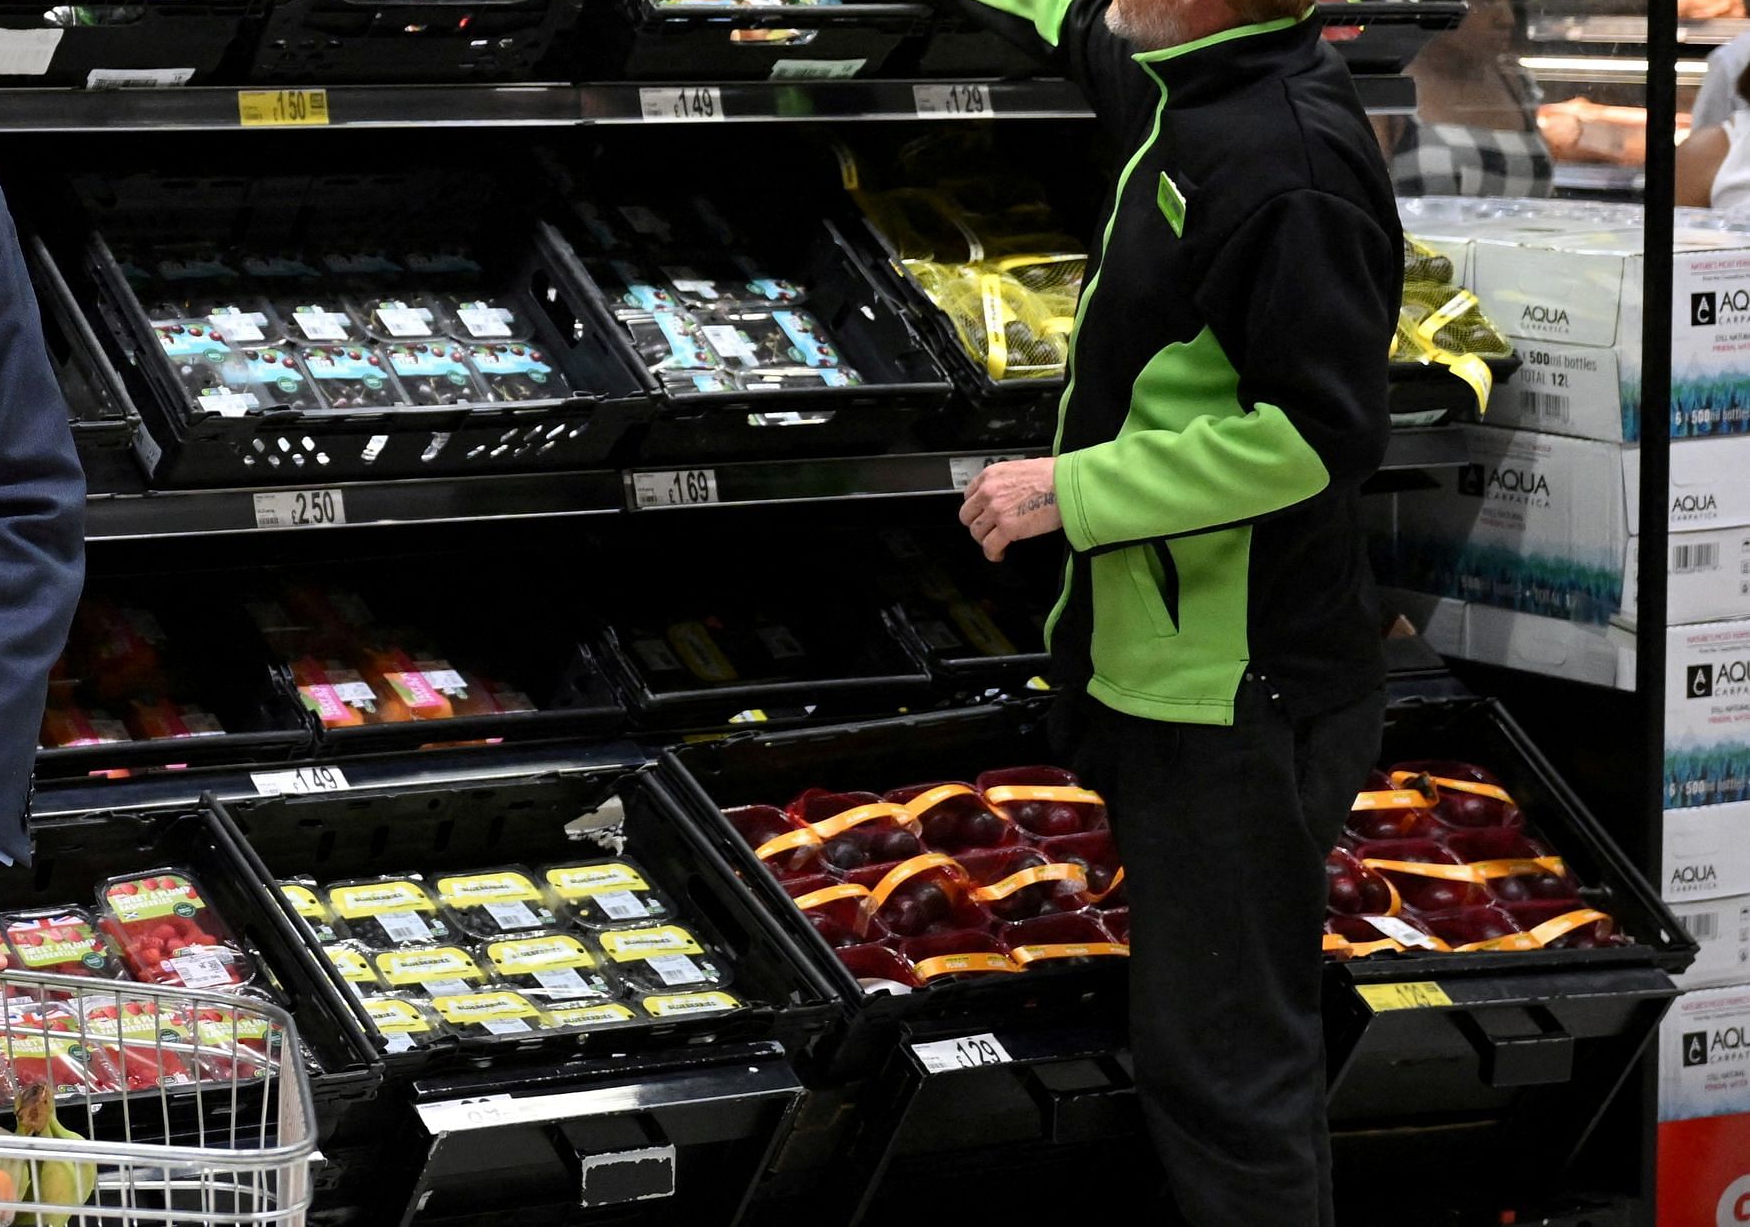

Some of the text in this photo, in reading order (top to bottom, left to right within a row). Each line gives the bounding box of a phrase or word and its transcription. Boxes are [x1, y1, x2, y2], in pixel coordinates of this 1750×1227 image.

[1521, 305, 1569, 325] AQUA
[1487, 469, 1550, 497] AQUA
[291, 491, 334, 524] £2.50
[1486, 491, 1550, 508] CARPATICA
[1672, 494, 1717, 512] AQUA
[1671, 864, 1717, 884] AQUA
